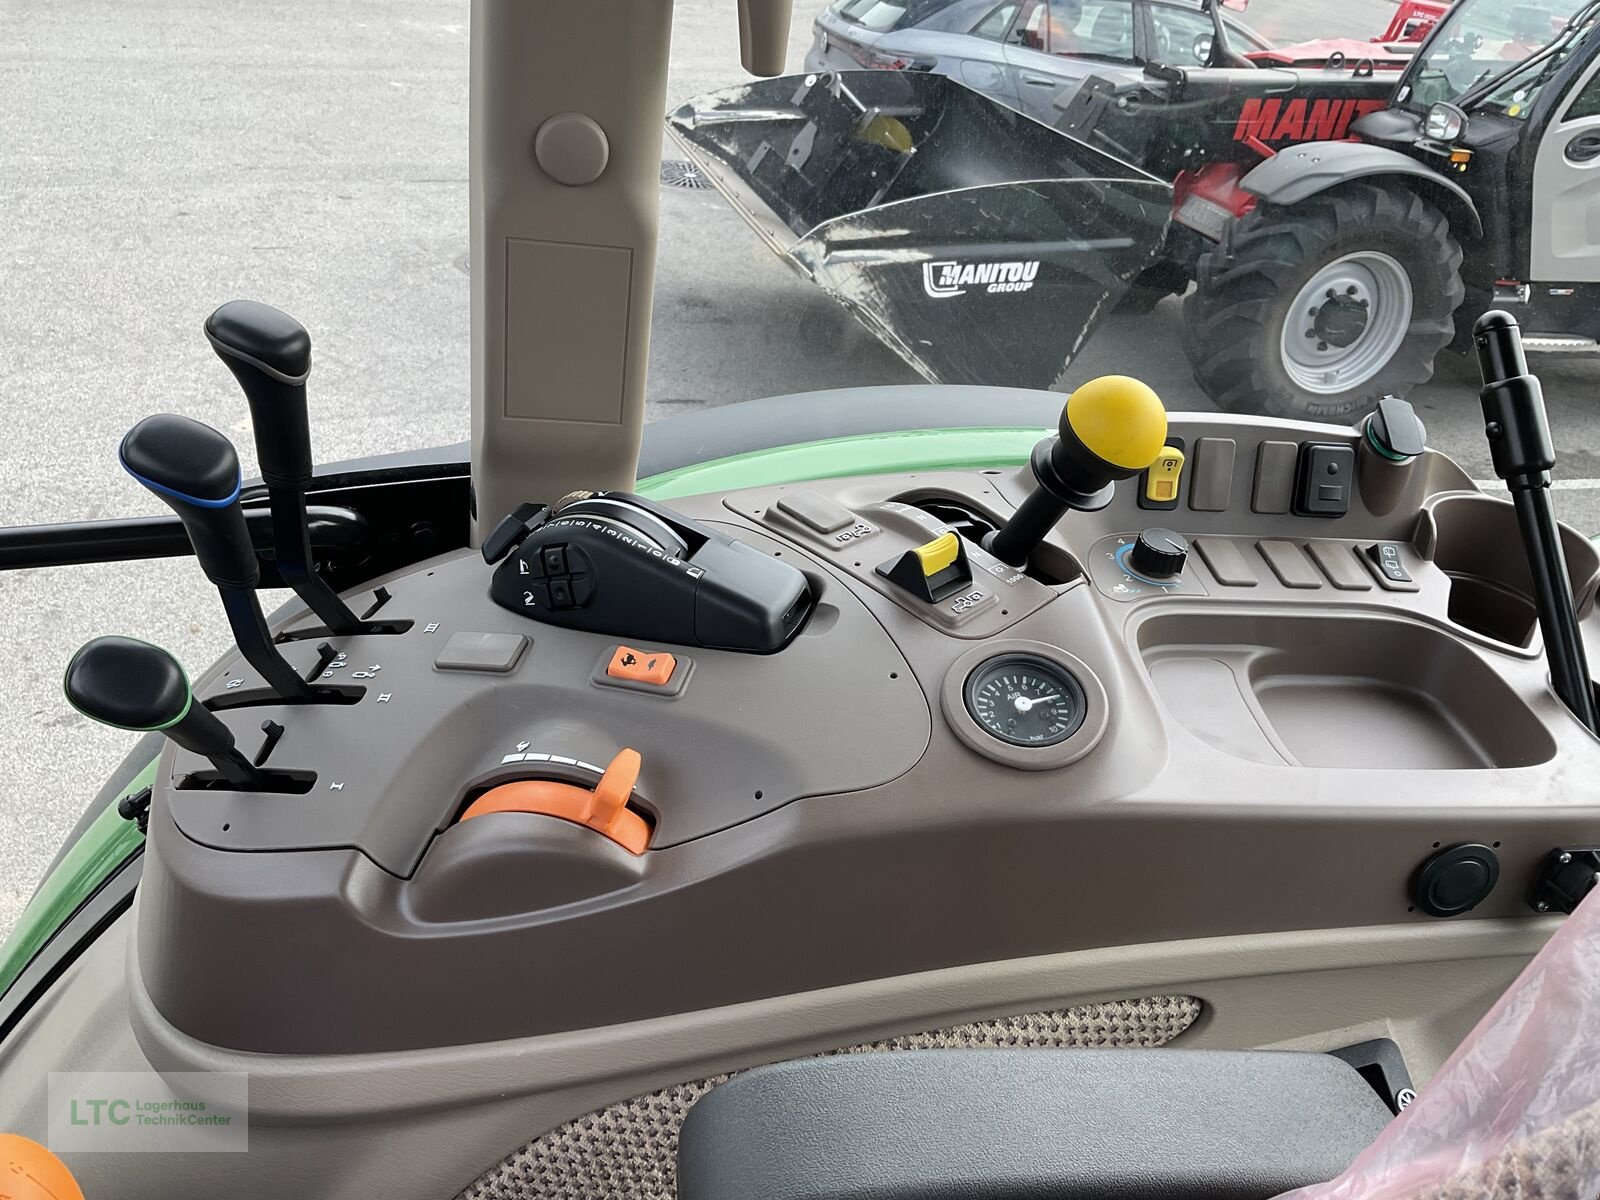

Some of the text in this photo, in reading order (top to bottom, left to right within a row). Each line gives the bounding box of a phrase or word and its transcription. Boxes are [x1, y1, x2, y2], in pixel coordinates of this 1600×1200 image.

[1233, 98, 1388, 140] MANIT
[939, 261, 1040, 285] MANITOU
[987, 281, 1033, 293] GROUP
[1007, 692, 1020, 700] AIR
